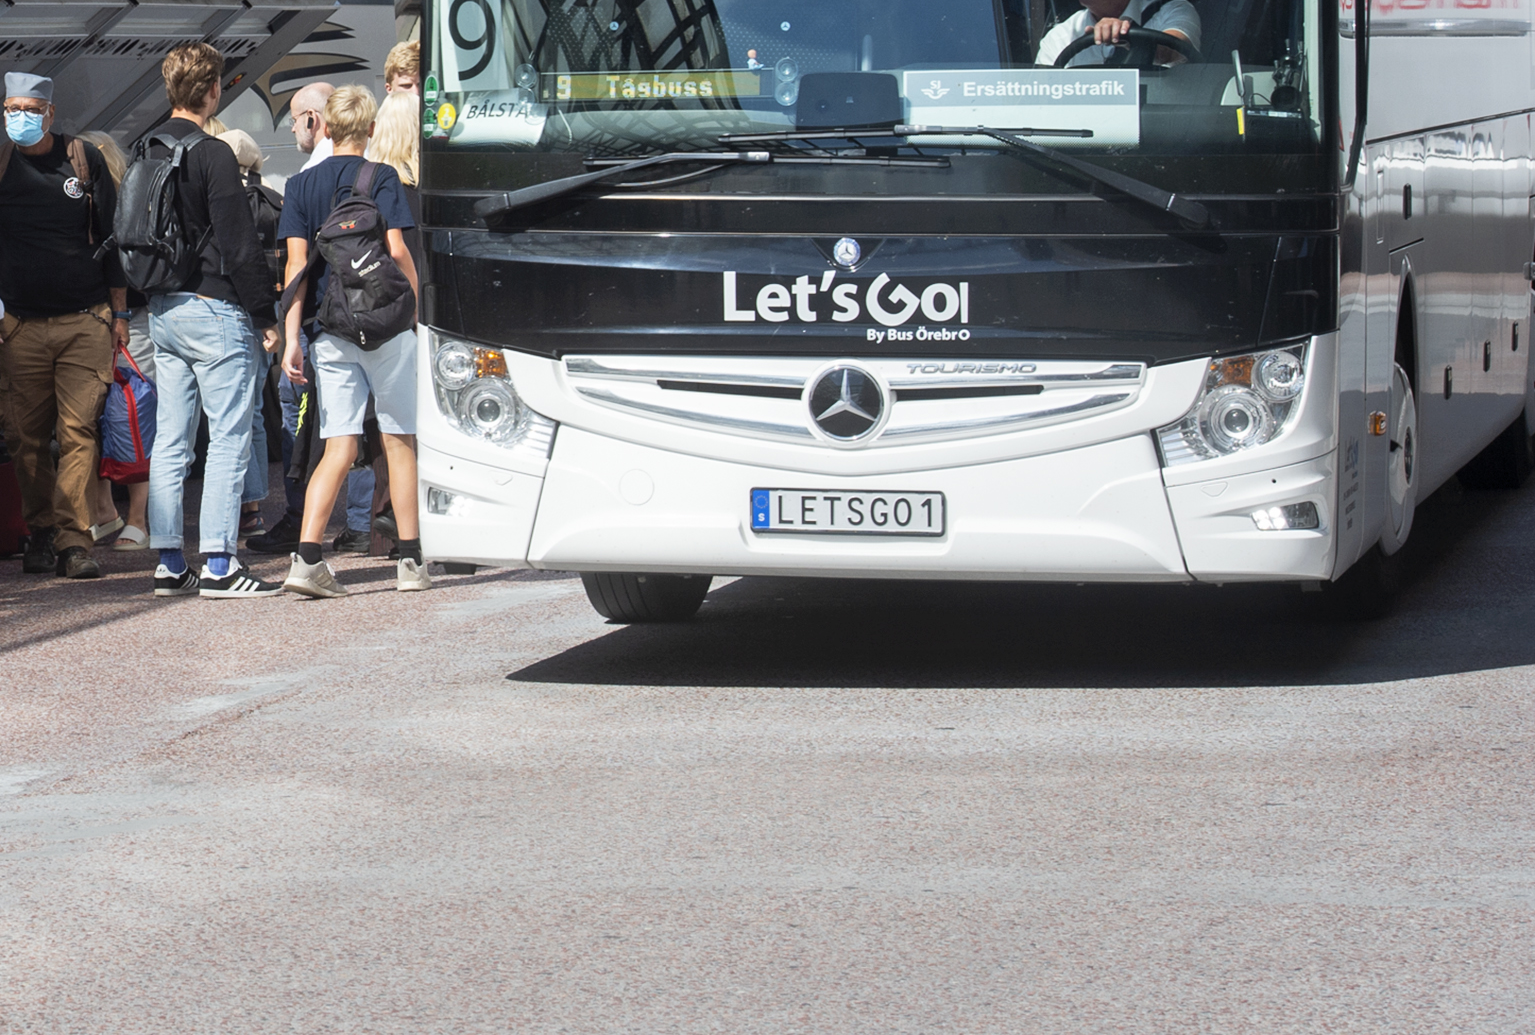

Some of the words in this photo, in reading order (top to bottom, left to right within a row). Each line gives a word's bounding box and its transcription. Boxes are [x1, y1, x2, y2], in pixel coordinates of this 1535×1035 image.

[557, 74, 571, 99] 9
[606, 74, 713, 98] Tågbuss
[964, 80, 1124, 99] Ersättningstrafik
[466, 99, 528, 119] BÅLSTA
[867, 328, 885, 344] By
[887, 328, 913, 341] Bus
[907, 363, 1037, 374] TOURISMO
[758, 513, 765, 522] S
[778, 495, 933, 528] LETSGO1
